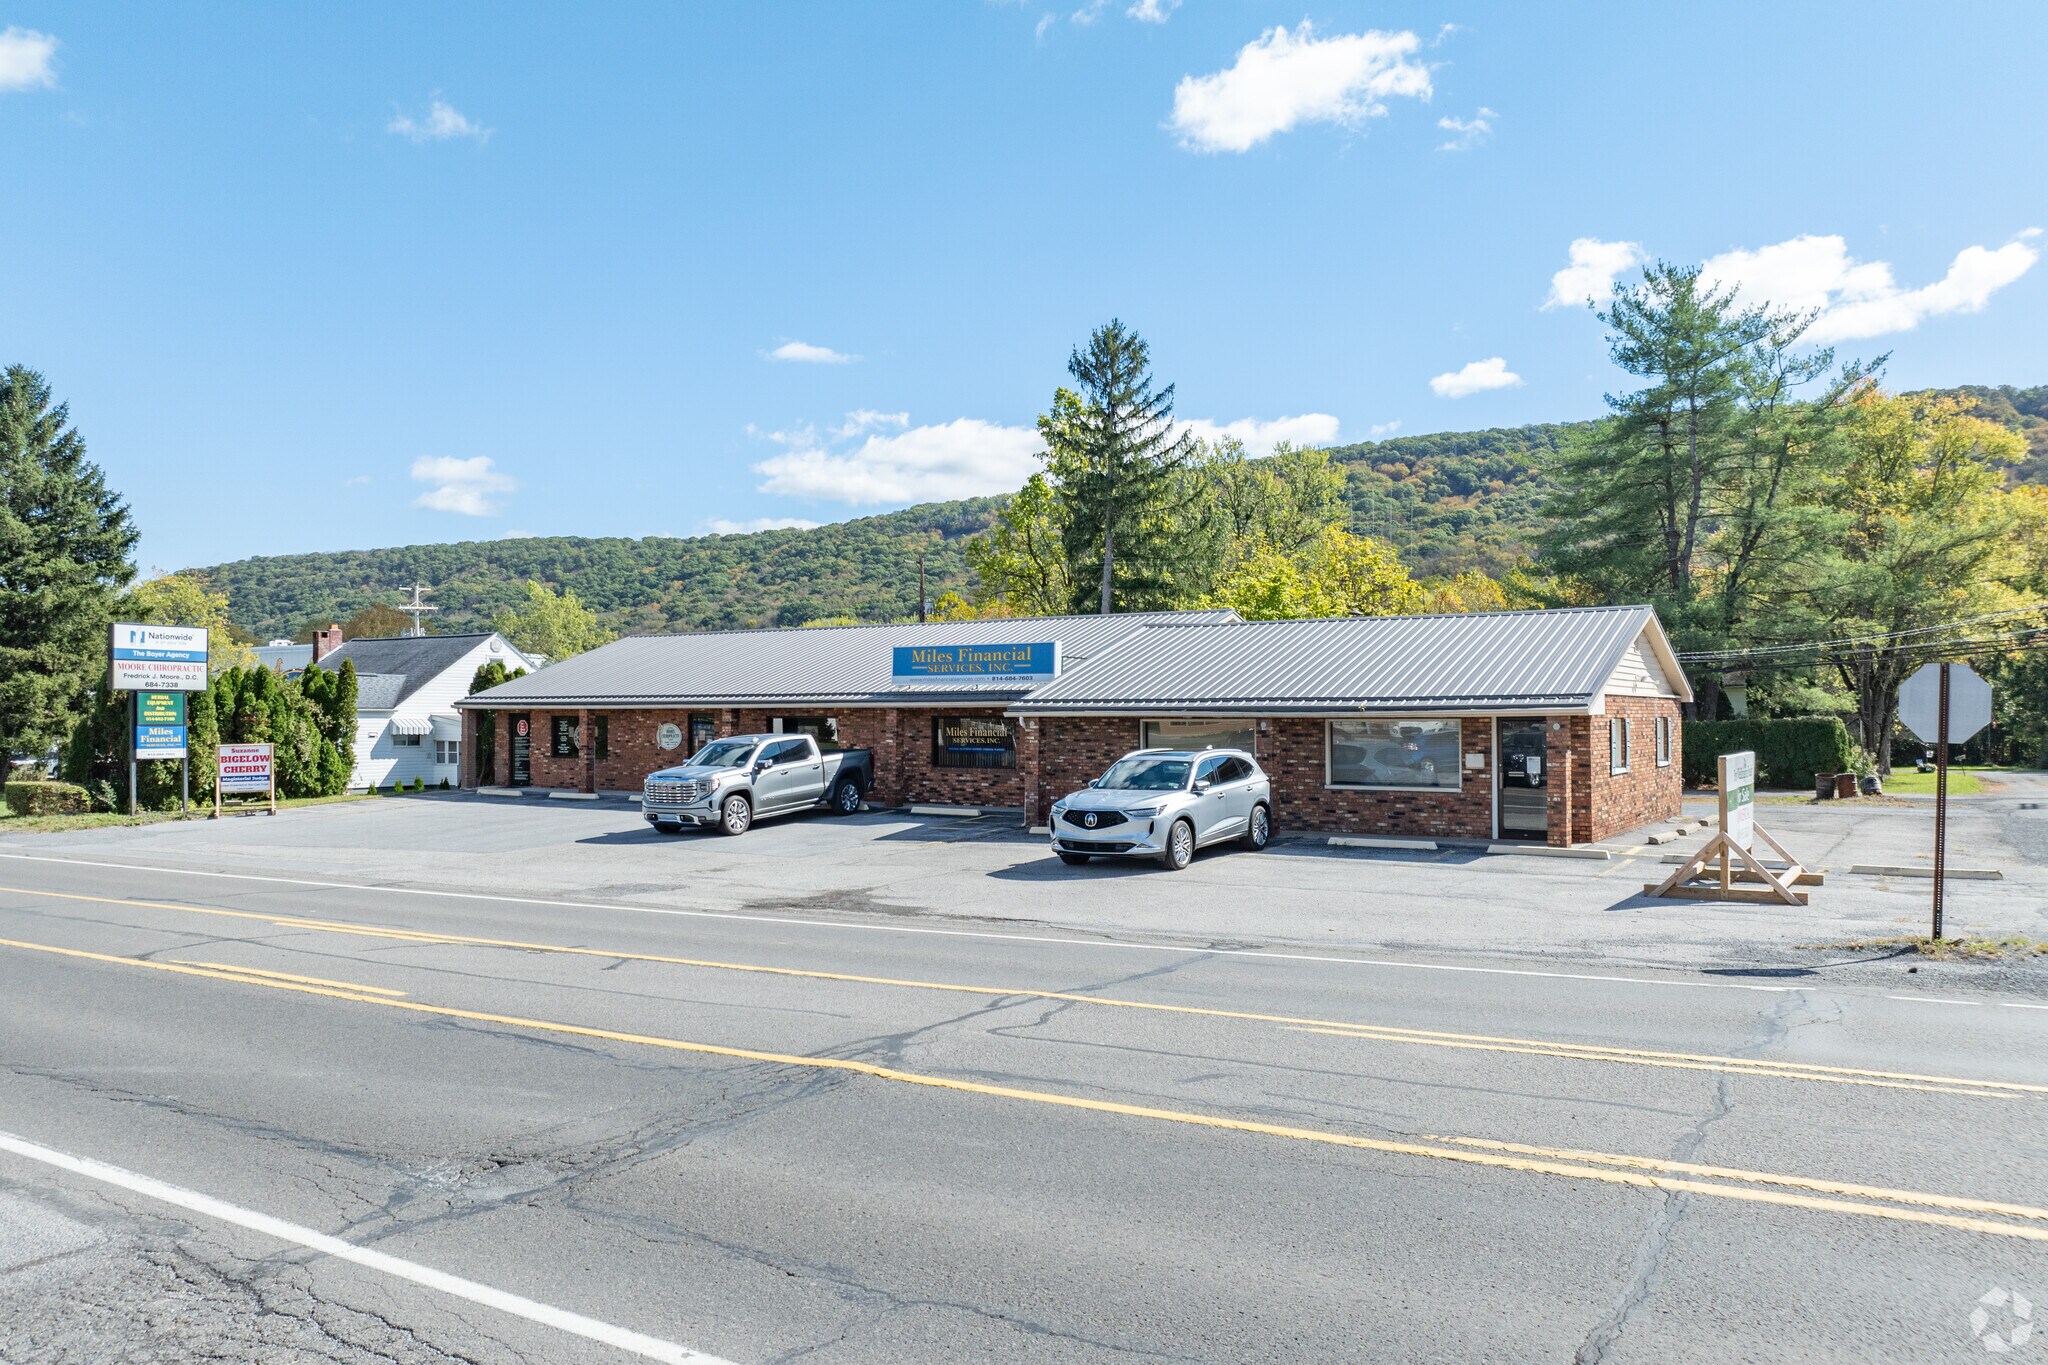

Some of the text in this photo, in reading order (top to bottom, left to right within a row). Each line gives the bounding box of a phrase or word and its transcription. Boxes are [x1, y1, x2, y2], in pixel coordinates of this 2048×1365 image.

[148, 632, 193, 641] Nationwide
[166, 651, 190, 660] Agency
[911, 645, 1032, 664] Miles Financial
[117, 662, 204, 673] MOORE CHIROPRACTIC
[927, 662, 1014, 674] SERVICES, INC.
[946, 726, 1008, 737] Miles Financial
[140, 735, 182, 743] Financial
[220, 755, 270, 763] BIGELOW
[224, 765, 267, 773] CHERRY
